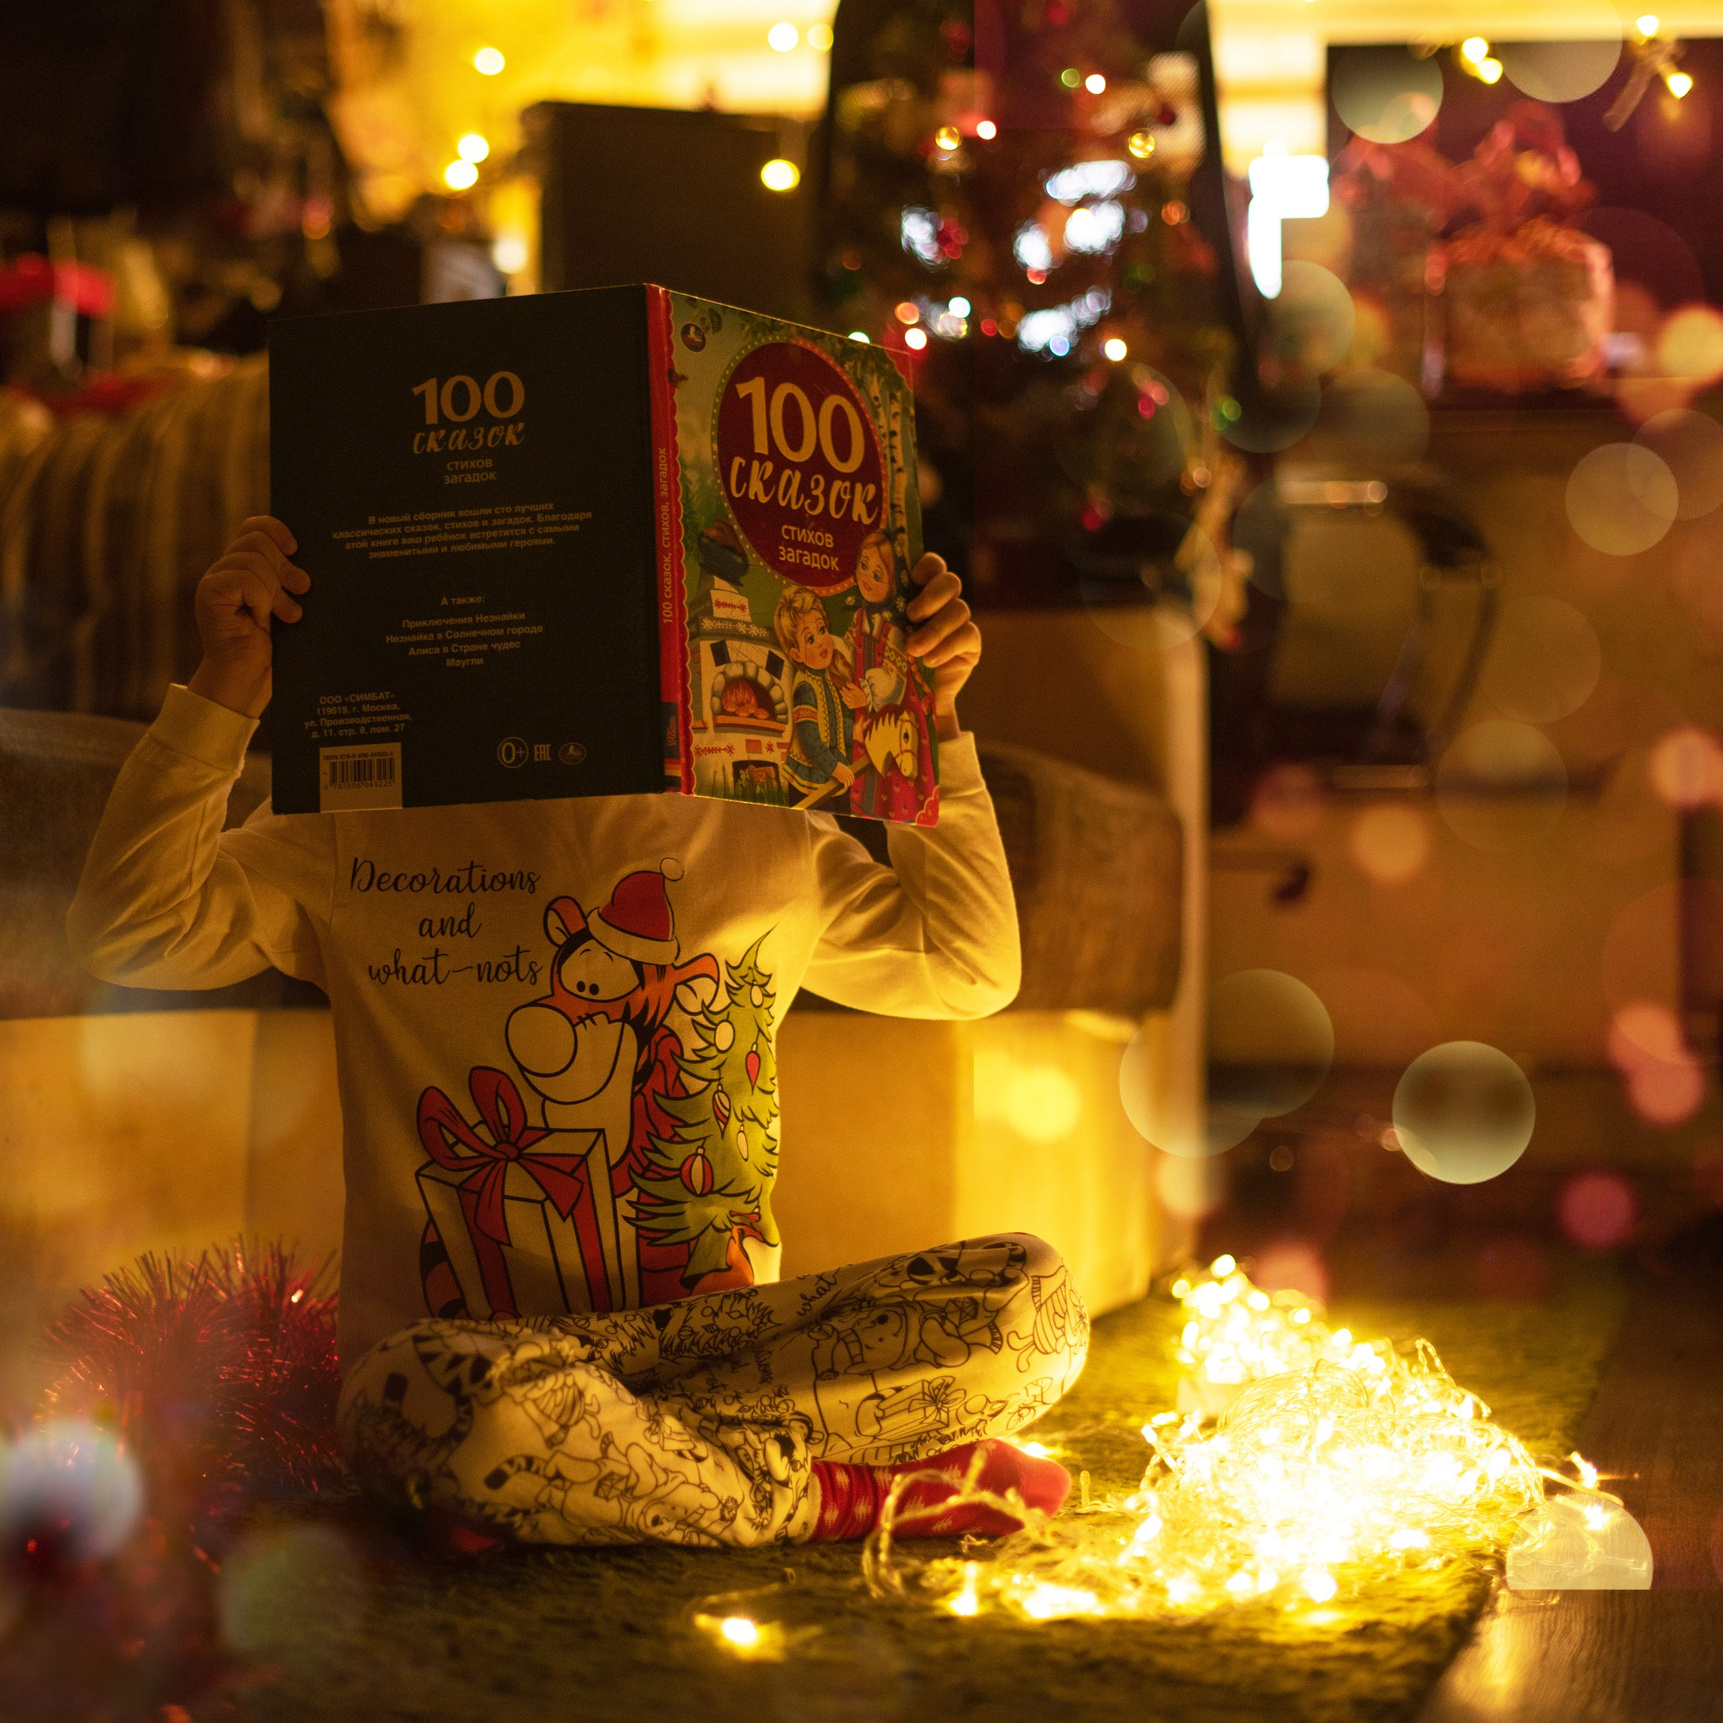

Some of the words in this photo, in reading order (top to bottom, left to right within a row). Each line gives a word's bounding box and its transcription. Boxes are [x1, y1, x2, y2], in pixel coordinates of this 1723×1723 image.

[412, 371, 525, 425] 100
[735, 376, 865, 474] 100
[413, 422, 526, 454] сказок
[446, 458, 493, 471] стихов
[658, 447, 668, 497] загадок
[443, 471, 497, 485] загадок
[730, 456, 879, 526] сказок
[332, 527, 402, 539] классических
[404, 523, 442, 533] сказок,
[444, 520, 479, 530] стихов
[481, 519, 488, 527] и
[491, 516, 534, 526] загадок.
[536, 511, 592, 522] Благодаря
[368, 515, 376, 525] В
[378, 512, 411, 524] новый
[413, 510, 456, 521] сборник
[458, 507, 492, 517] вошли
[494, 505, 512, 514] сто
[514, 503, 554, 514] лучших
[660, 502, 670, 548] стихов,
[345, 539, 368, 550] этой
[370, 537, 399, 547] книге
[401, 536, 422, 545] ваш
[424, 531, 467, 544] ребёнок
[469, 527, 526, 540] встретится
[528, 527, 535, 535] с
[537, 524, 580, 533] самыми
[781, 524, 834, 548] стихов
[368, 546, 439, 559] знаменитыми
[441, 545, 448, 553] и
[450, 541, 507, 552] любимыми
[509, 538, 555, 549] героями.
[778, 546, 840, 572] загадок
[662, 552, 672, 599] сказок,
[441, 597, 449, 606] А
[451, 595, 485, 605] также:
[402, 616, 473, 630] Приключения
[476, 612, 526, 623] Незнайки
[662, 601, 673, 624] 100
[386, 631, 434, 644] Незнайка
[437, 632, 443, 640] в
[445, 628, 504, 639] Солнечном
[506, 624, 543, 635] городе
[409, 646, 440, 656] Алиса
[442, 645, 448, 653] в
[451, 642, 488, 654] Стране
[491, 640, 521, 651] чудес
[446, 656, 484, 668] Маугли
[319, 695, 342, 705] ООО
[304, 721, 317, 729] ул.
[311, 731, 320, 739] д.
[338, 728, 357, 737] стр.
[370, 725, 391, 734] пом.
[394, 723, 405, 732] 27
[501, 742, 525, 764] 0+
[350, 857, 541, 894] Decorations
[418, 902, 482, 938] and
